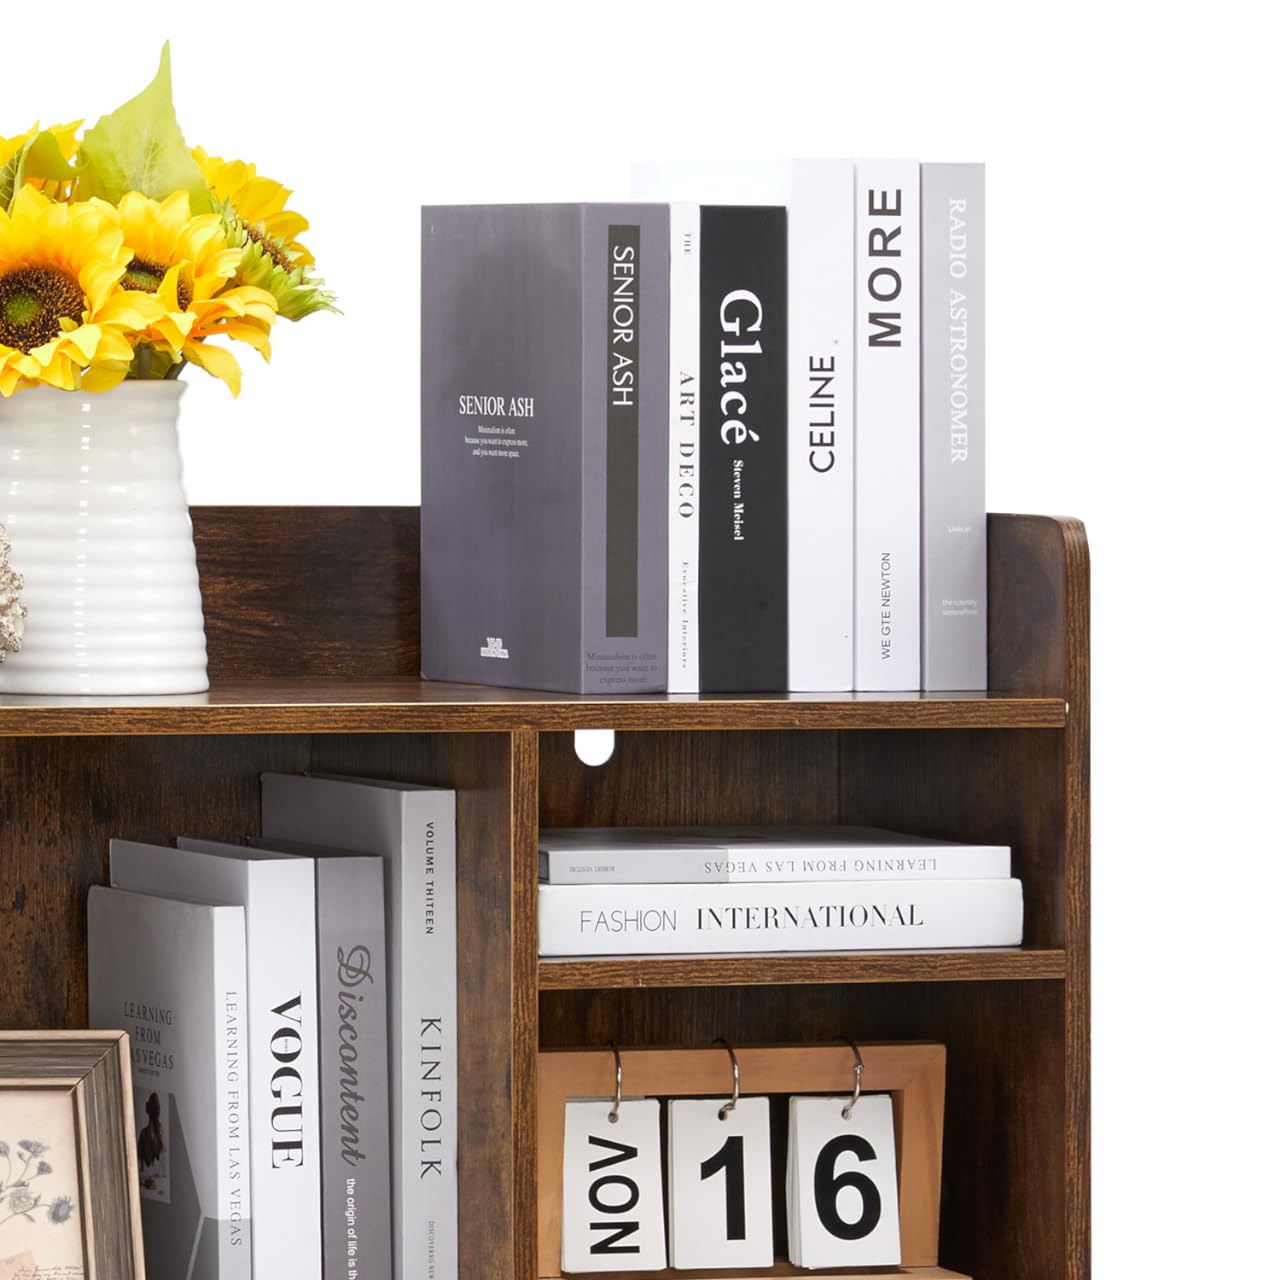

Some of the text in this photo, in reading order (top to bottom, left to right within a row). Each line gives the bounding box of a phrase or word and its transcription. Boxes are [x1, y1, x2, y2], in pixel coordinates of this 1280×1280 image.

[683, 232, 691, 256] THE
[868, 189, 903, 347] MORE
[612, 246, 635, 406] SENIOR ASH
[720, 289, 763, 445] Glacé
[949, 198, 968, 464] RADIO ASTRONOMER
[459, 395, 534, 417] SENIOR ASH
[679, 371, 695, 519] ART DECO
[809, 356, 835, 473] CELINE
[733, 459, 744, 541] Steven Meisel
[881, 552, 891, 660] WE GTE NEWTON
[425, 821, 434, 935] VOLUME THITEEN
[580, 904, 925, 933] FASHION INTERNATIONAL
[704, 858, 937, 874] LEARNING FROM LAS VEGAS
[124, 1001, 173, 1026] LEARNING
[135, 1026, 161, 1046] FROM
[142, 1049, 174, 1071] VEGAS
[337, 945, 374, 1167] Discontent
[226, 991, 242, 1246] LEARNING FROM LAS VEGAS
[270, 991, 304, 1168] VOGUE
[420, 1017, 442, 1179] KINFOLK
[345, 1198, 357, 1226] origin
[346, 1178, 356, 1194] the
[347, 1229, 357, 1240] of
[588, 1135, 640, 1256] NOV
[699, 1136, 747, 1241] 1
[814, 1134, 882, 1241] 6
[347, 1241, 358, 1257] life
[348, 1259, 358, 1268] is
